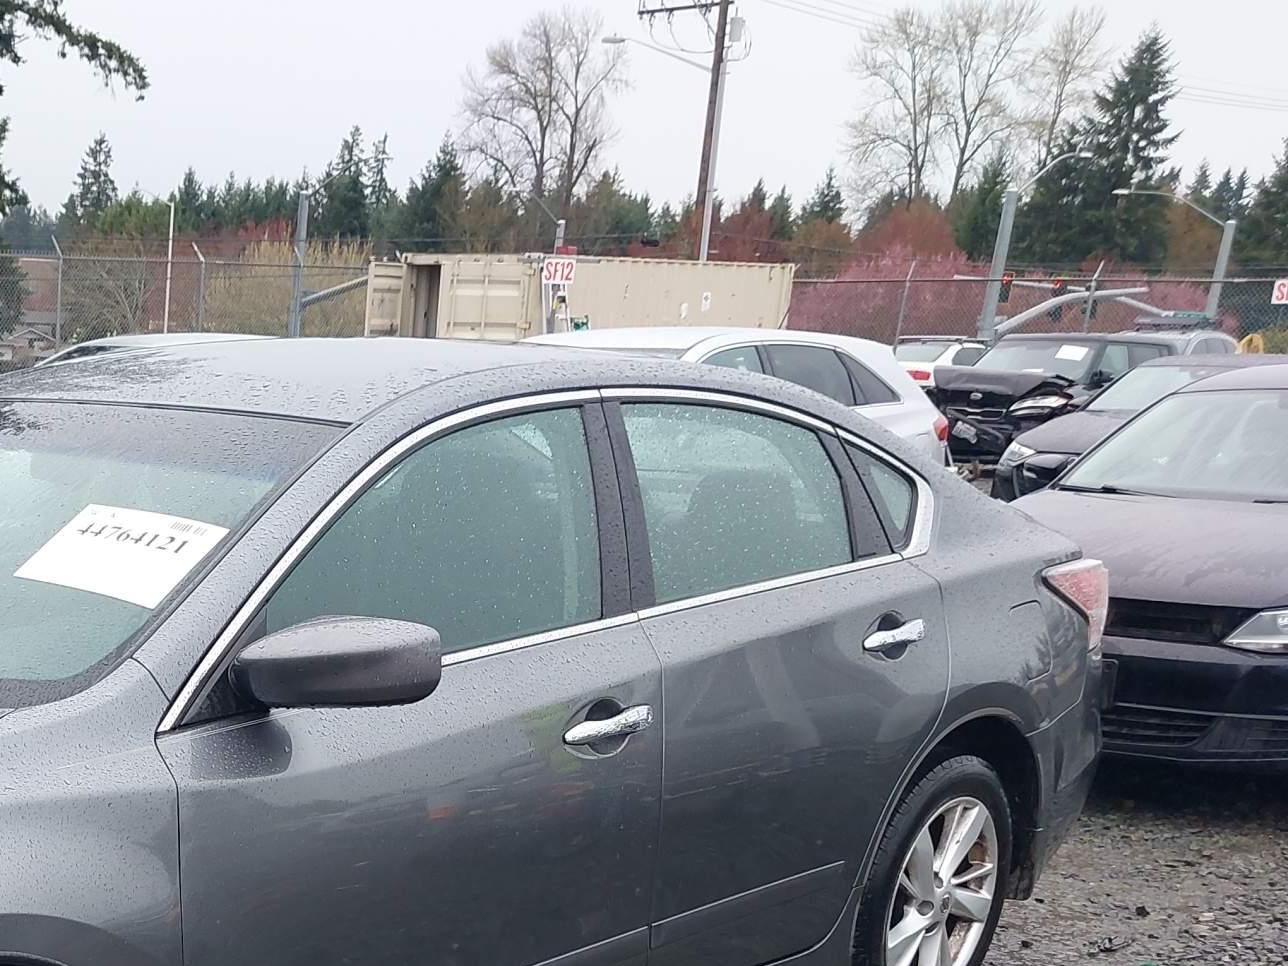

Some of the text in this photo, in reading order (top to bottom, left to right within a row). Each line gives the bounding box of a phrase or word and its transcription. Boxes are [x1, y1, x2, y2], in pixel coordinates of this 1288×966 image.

[544, 261, 574, 281] SF12
[1276, 282, 1288, 302] S
[77, 522, 189, 554] 44764121
